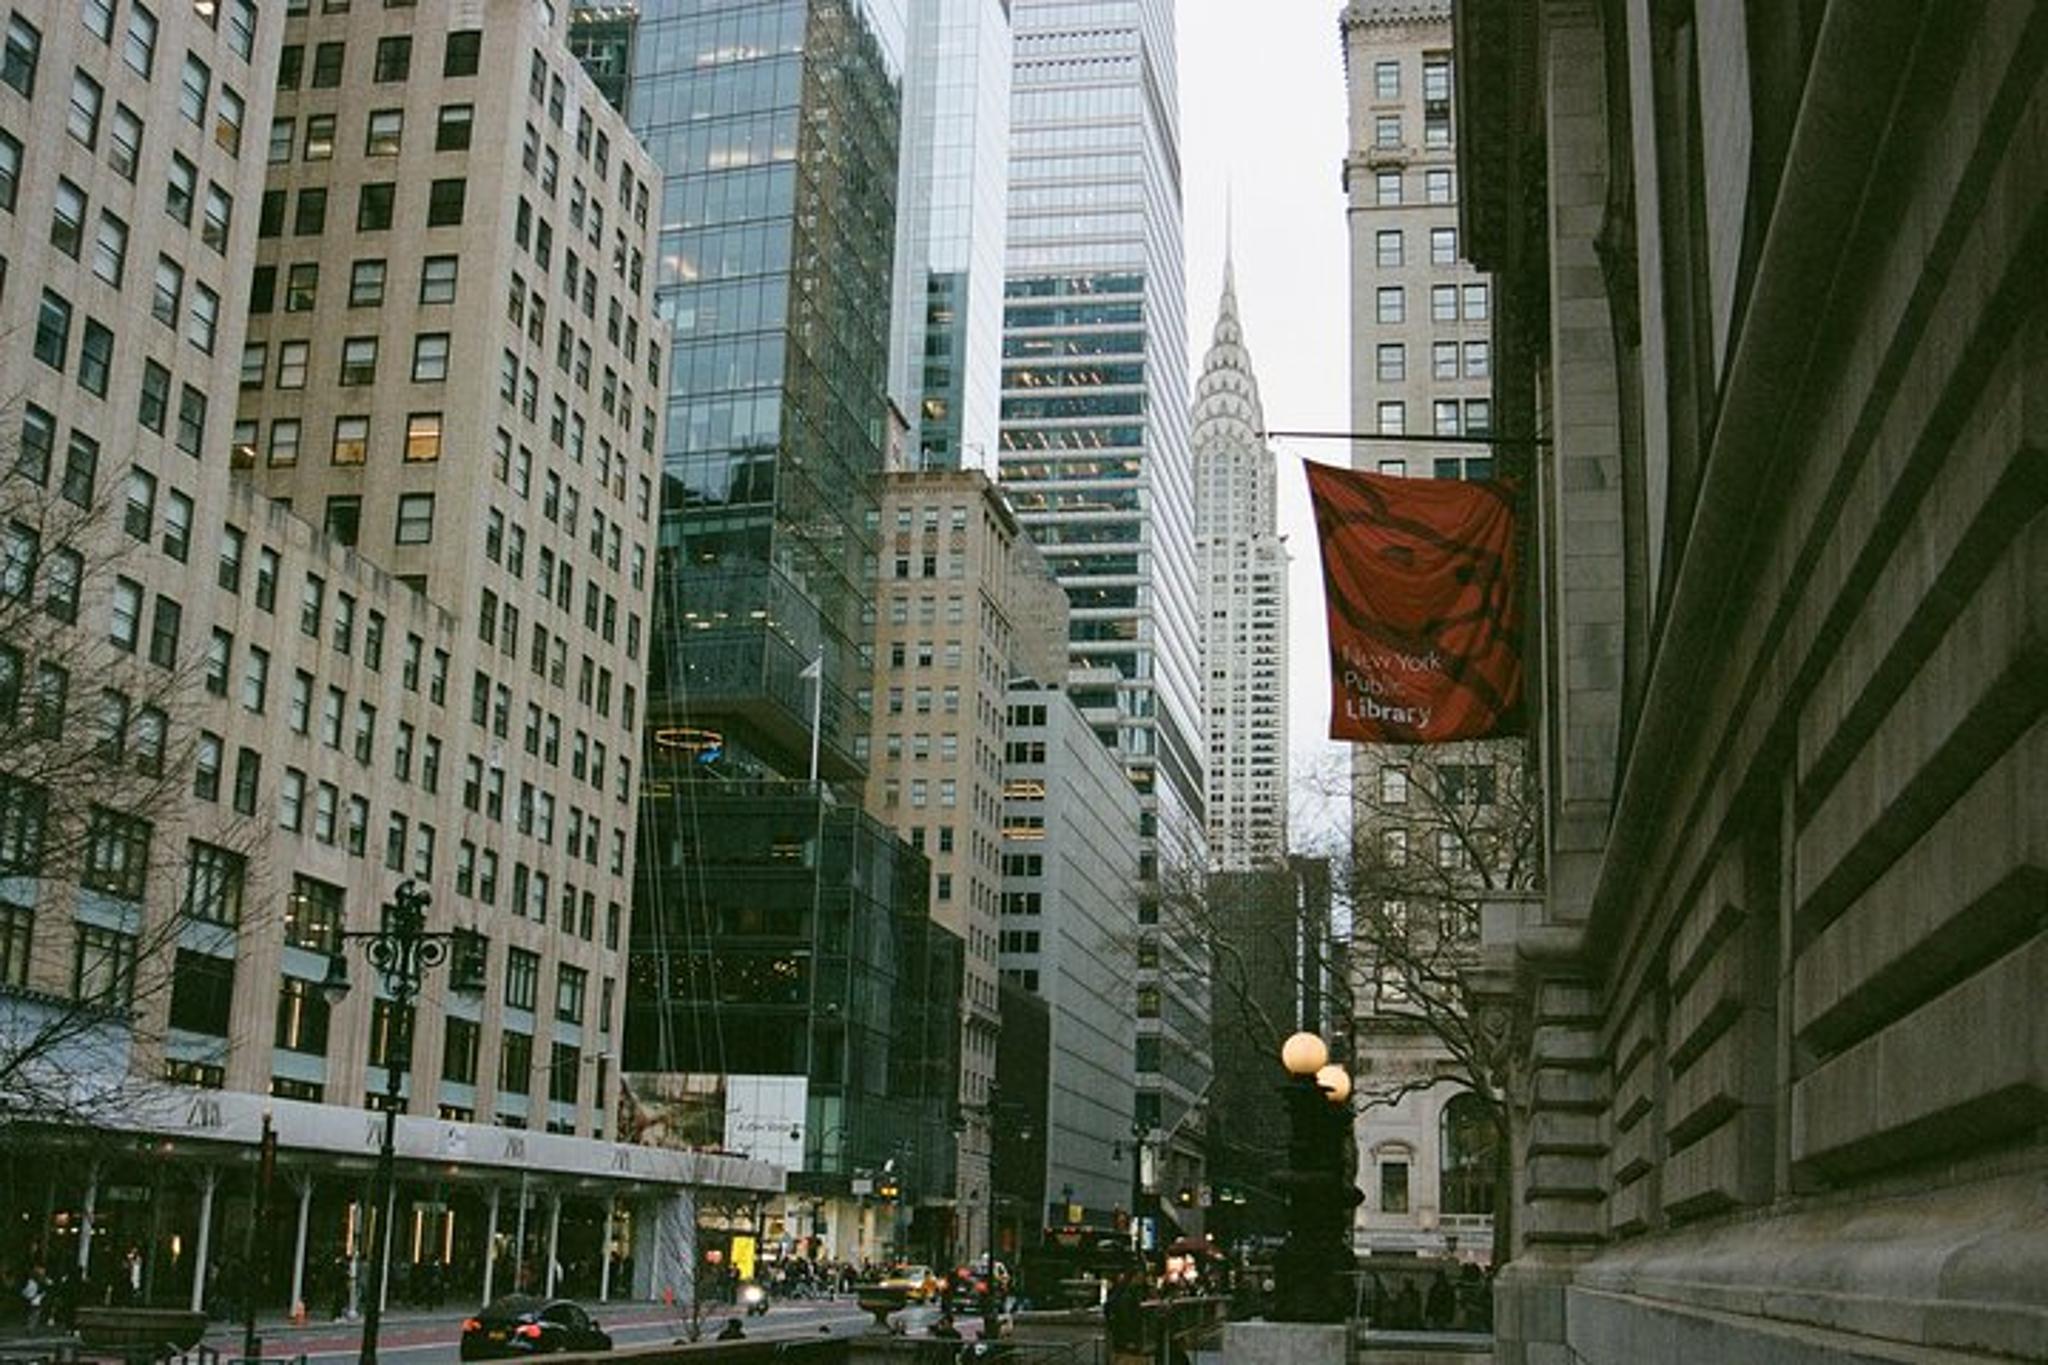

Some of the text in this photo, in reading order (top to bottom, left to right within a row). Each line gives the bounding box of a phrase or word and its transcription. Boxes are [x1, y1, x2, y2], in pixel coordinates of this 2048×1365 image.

[1393, 651, 1441, 672] York
[1345, 670, 1406, 697] Pub
[1346, 697, 1432, 729] Library
